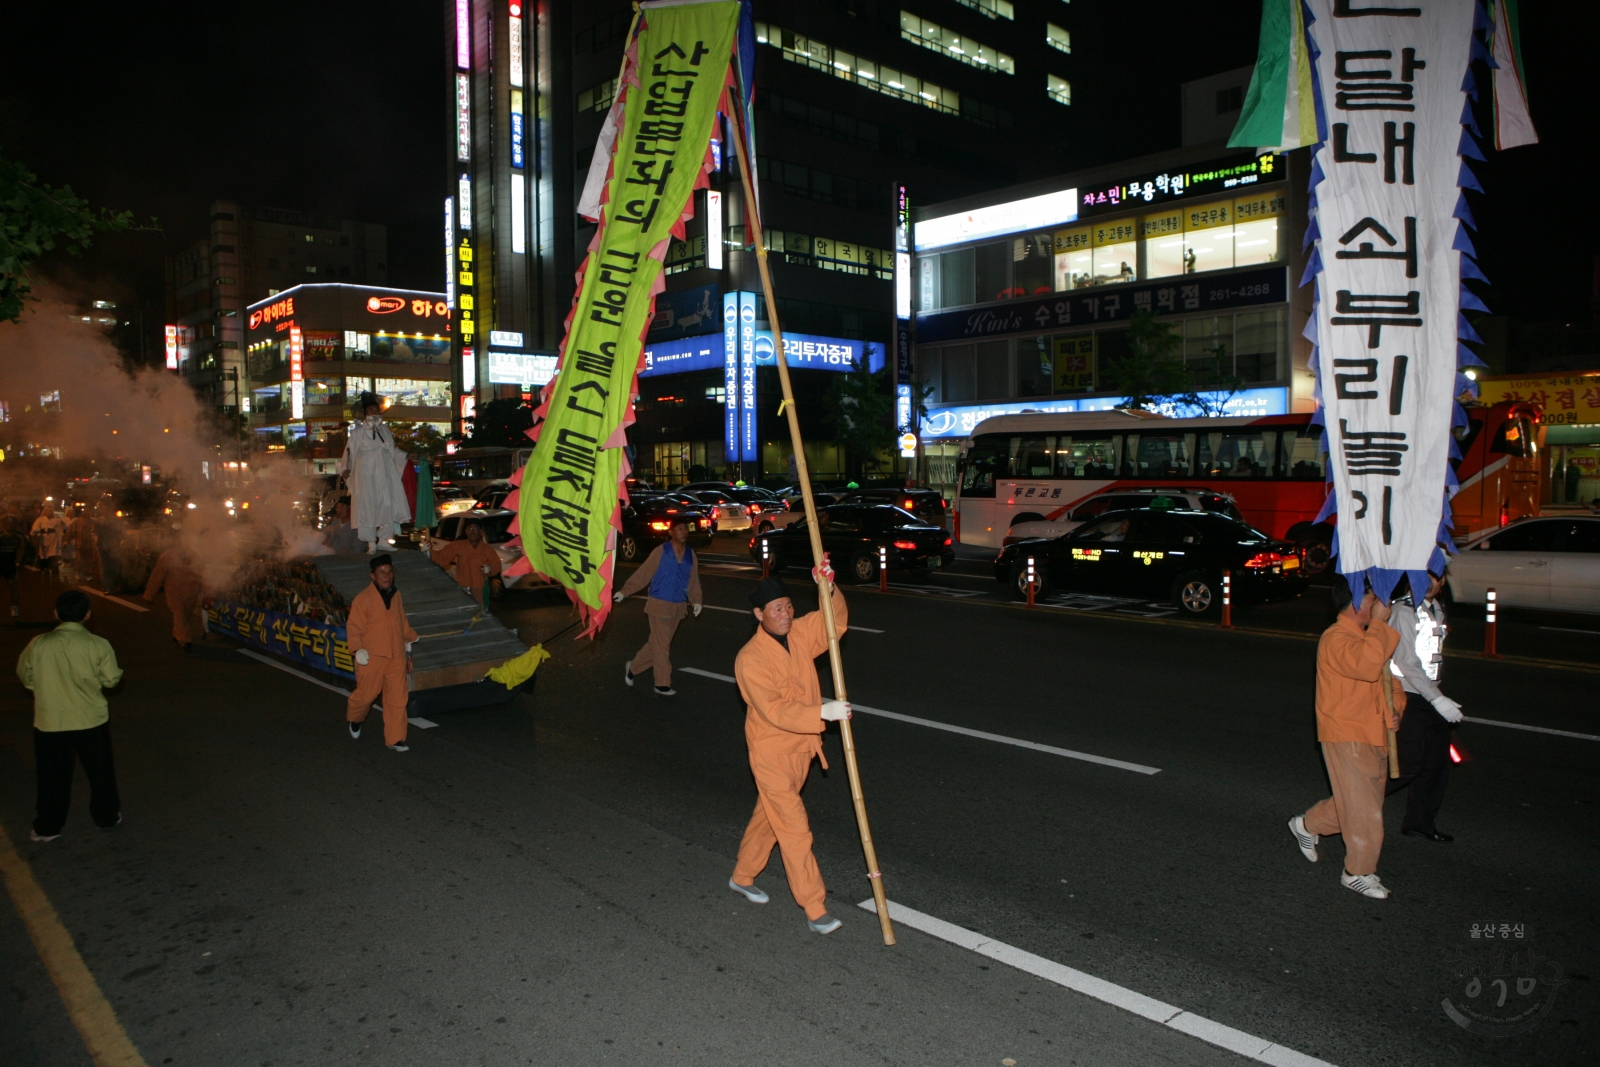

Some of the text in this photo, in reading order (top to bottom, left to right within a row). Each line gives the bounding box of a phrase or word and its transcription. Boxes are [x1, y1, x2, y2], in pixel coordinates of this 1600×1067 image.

[1332, 48, 1426, 185] 달내
[615, 40, 709, 233] 산업문화의
[1083, 173, 1184, 205] 차소민 무용학원
[1191, 211, 1228, 227] 한국무용
[263, 297, 294, 322] 하이마트
[1034, 302, 1071, 326] 수입
[1082, 295, 1121, 320] 가구
[1133, 284, 1200, 313] 백화점
[1209, 283, 1270, 301] 261-4268
[726, 326, 737, 409] 우리투자증권
[743, 326, 755, 409] 우리투자증권
[782, 338, 853, 365] 우리투자증권
[331, 386, 341, 394] TV
[1330, 216, 1423, 546] 쇠부리놀이
[1509, 380, 1542, 389] 100%
[1013, 487, 1063, 499] 푸른교통
